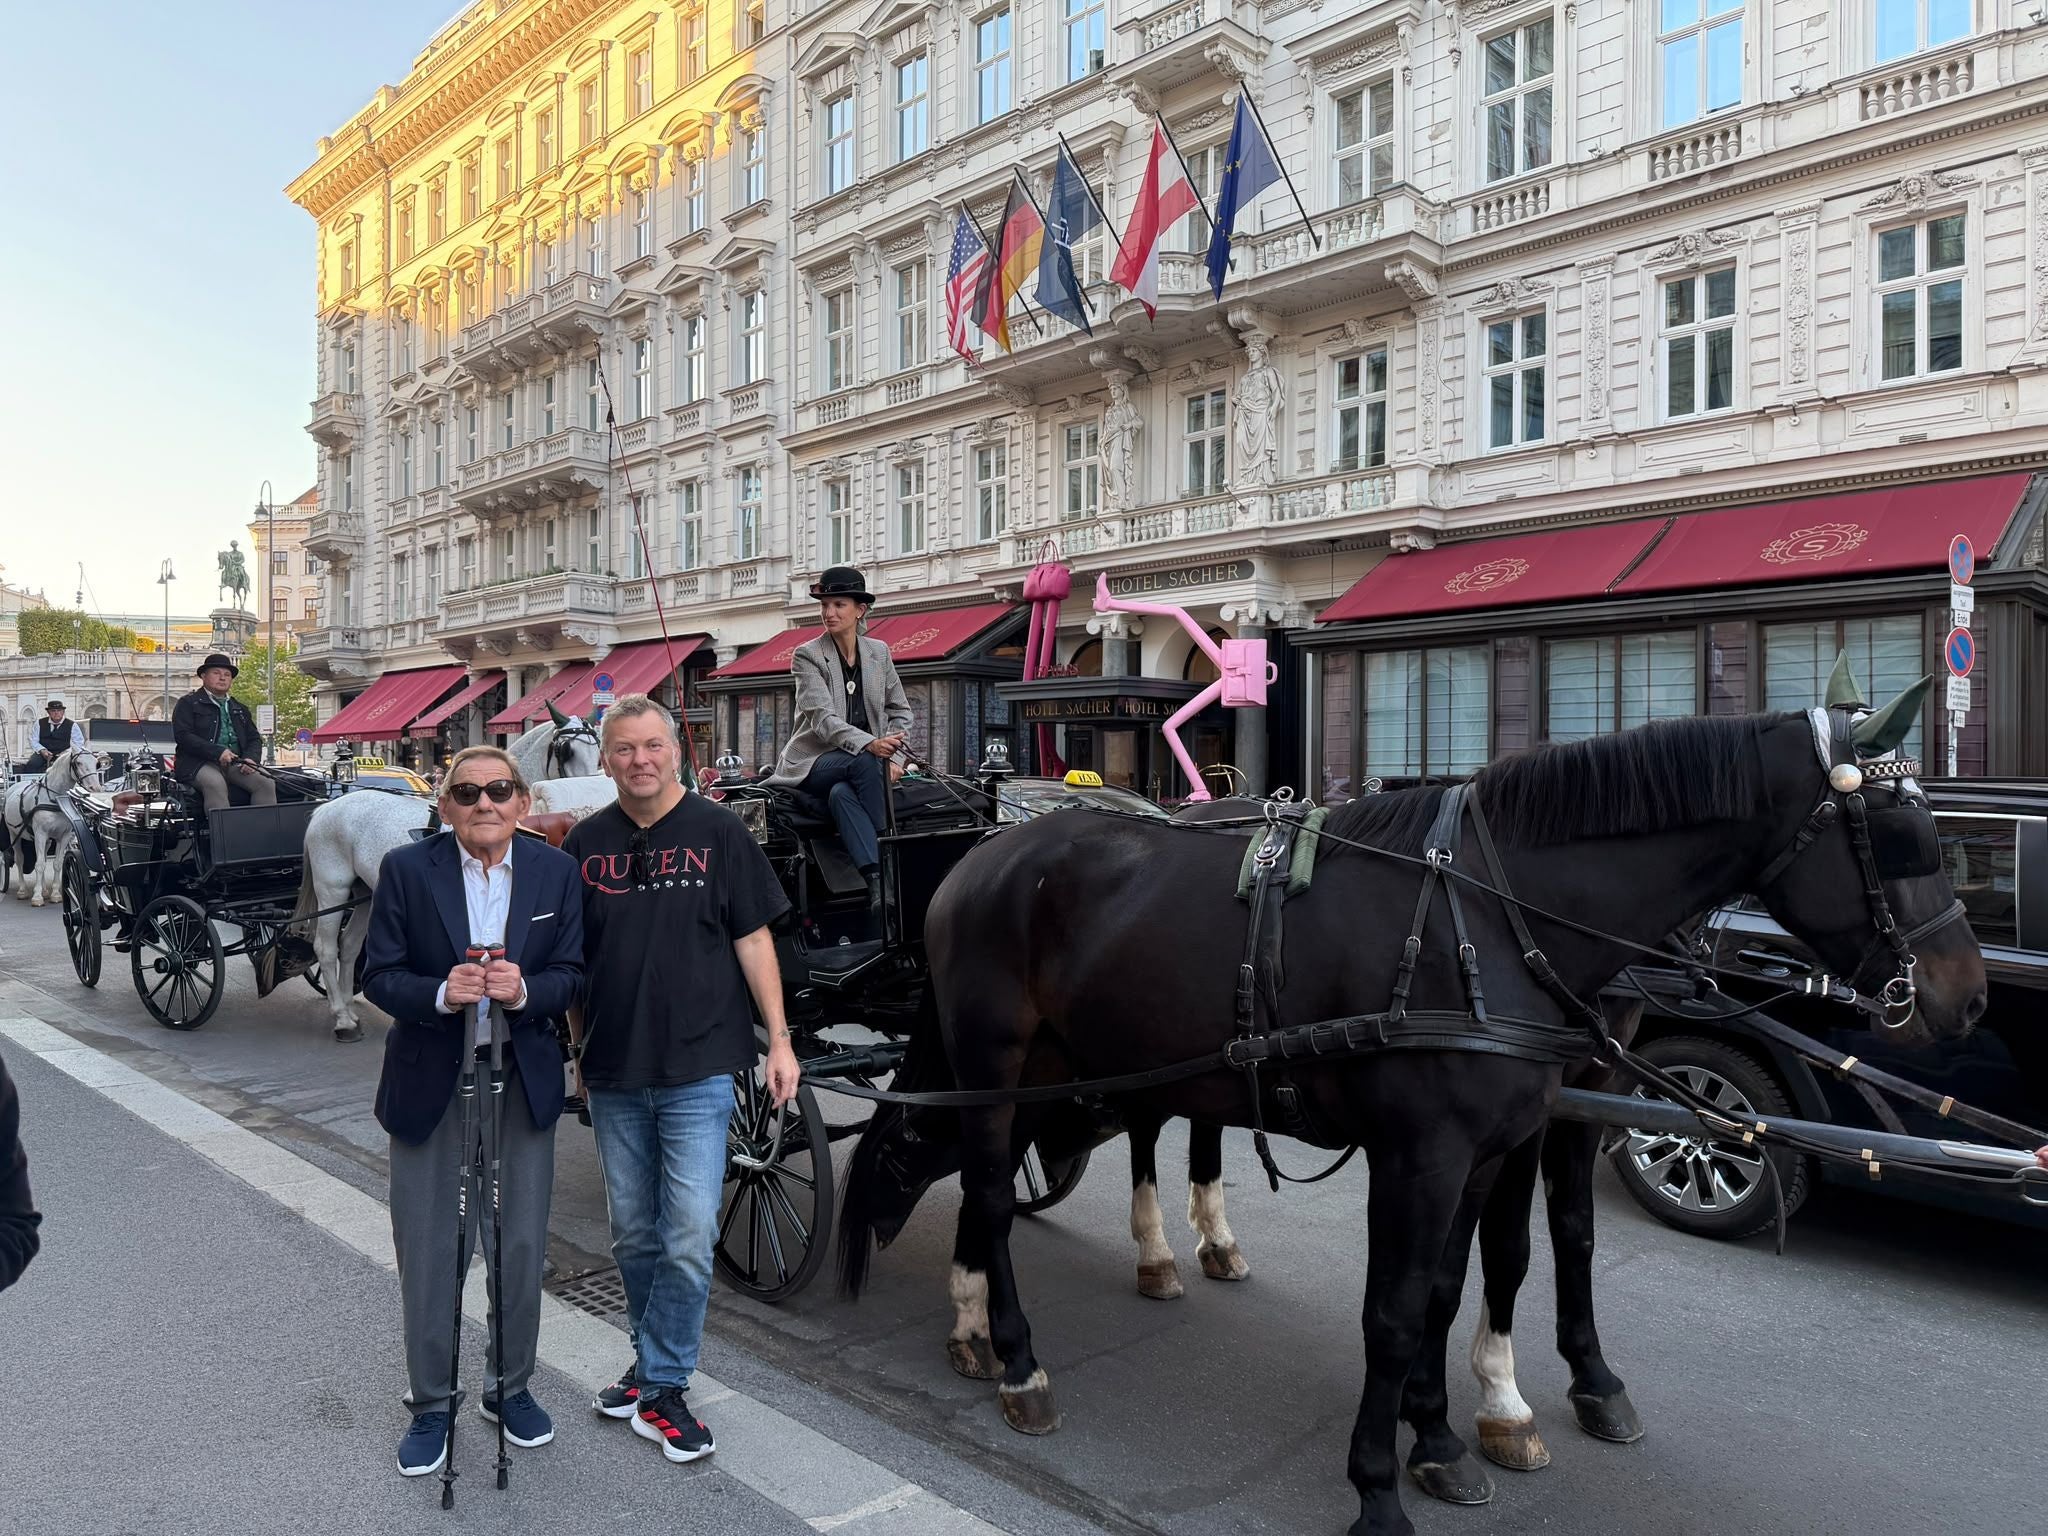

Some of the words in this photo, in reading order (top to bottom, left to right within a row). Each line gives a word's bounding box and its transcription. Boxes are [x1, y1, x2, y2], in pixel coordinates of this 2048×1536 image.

[1111, 578, 1162, 594] HOTEL
[1168, 563, 1239, 587] SACHER
[1026, 703, 1062, 717] HOTEL
[1066, 700, 1111, 715] SACHER
[1125, 701, 1159, 715] HOTEL
[357, 758, 384, 766] TAXI
[1078, 772, 1100, 784] TAXI
